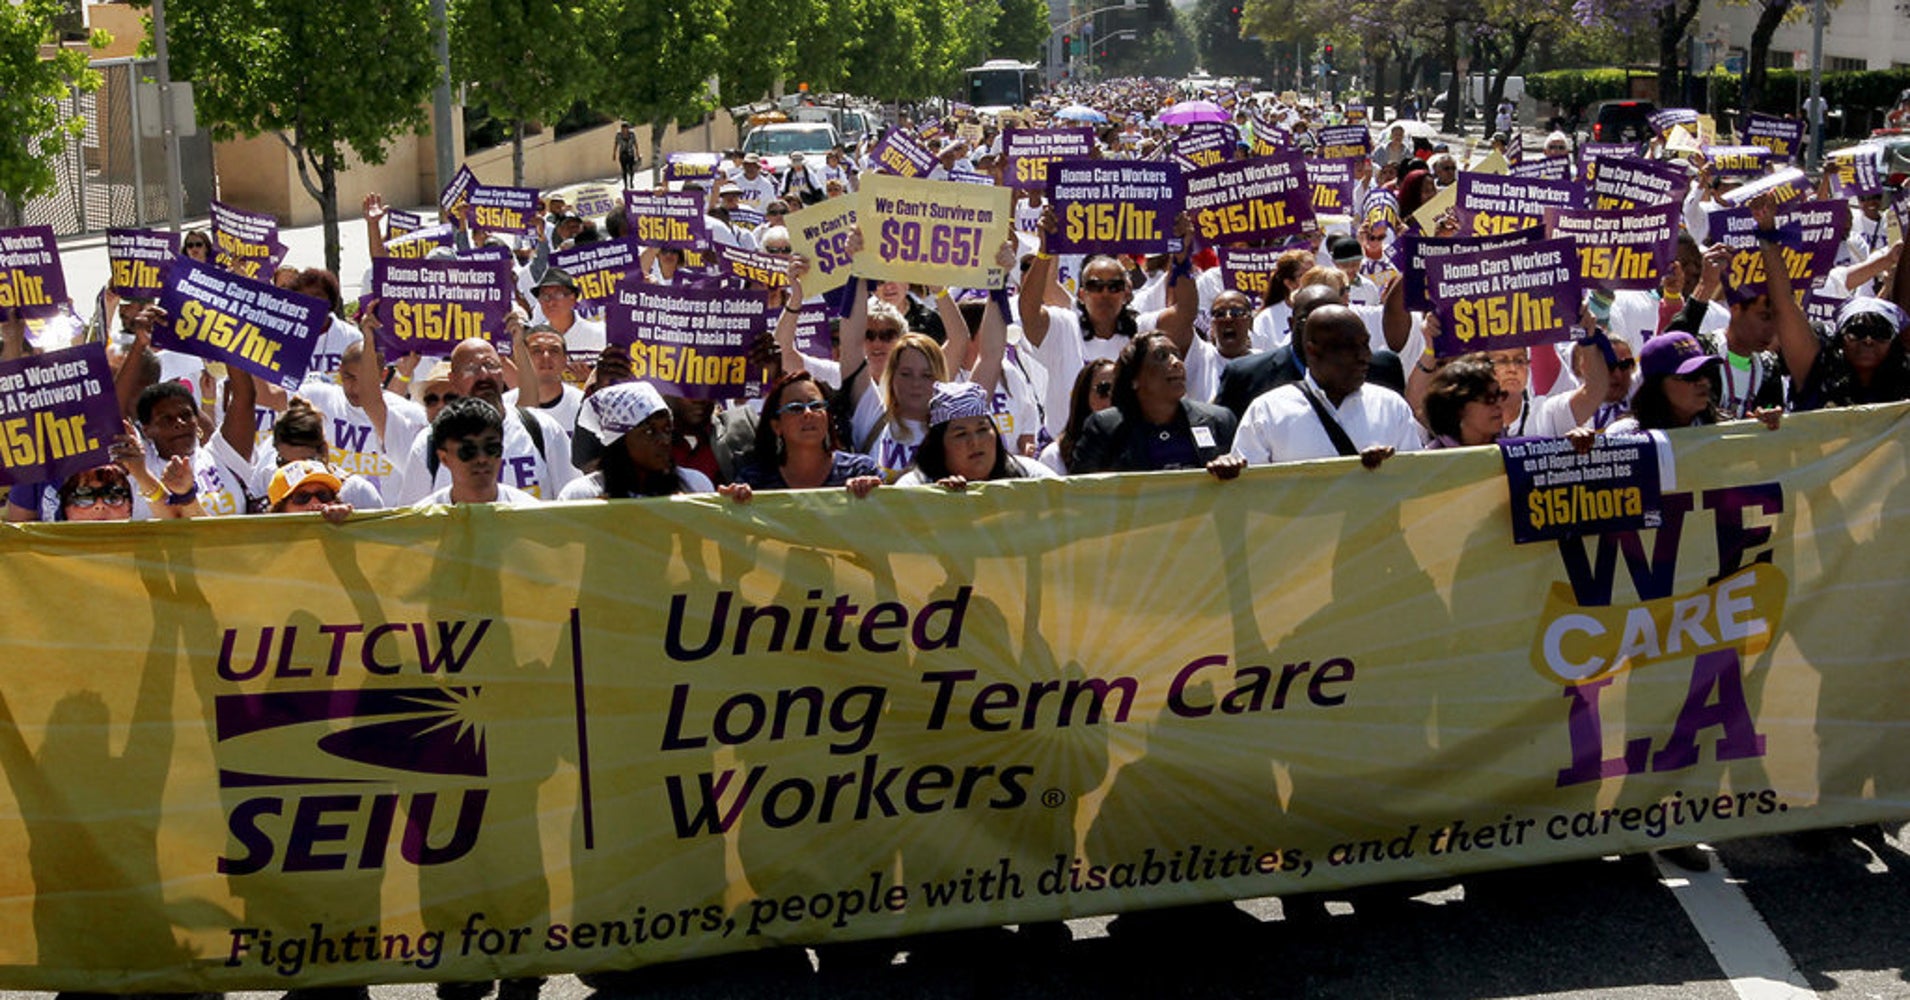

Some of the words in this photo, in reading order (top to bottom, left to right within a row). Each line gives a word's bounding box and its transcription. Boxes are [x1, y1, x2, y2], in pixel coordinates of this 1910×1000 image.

[1061, 169, 1093, 183] Home
[1094, 169, 1119, 183] Care
[1121, 168, 1166, 183] Workers
[1188, 178, 1217, 194] Home
[1218, 172, 1244, 187] Care
[1245, 163, 1290, 182] Workers
[1471, 180, 1500, 195] Home
[1502, 183, 1526, 198] Care
[1528, 185, 1570, 202] Workers
[875, 197, 894, 213] We
[897, 199, 927, 218] Can't
[930, 203, 975, 221] Survive
[976, 210, 993, 222] on
[1055, 185, 1100, 199] Deserve
[1101, 185, 1110, 198] A
[1112, 185, 1159, 201] Pathway
[1161, 186, 1172, 199] to
[1185, 191, 1228, 210] Deserve
[1229, 188, 1238, 201] A
[1239, 180, 1285, 200] Pathway
[1286, 177, 1299, 190] to
[1465, 194, 1507, 211] Deserve
[1508, 199, 1515, 212] A
[475, 206, 526, 229] $15/hr.
[638, 215, 694, 241] $15/hr.
[804, 225, 819, 241] We
[821, 214, 846, 234] Can't
[1066, 201, 1162, 243] $15/hr.
[1198, 200, 1295, 240] $15/hr.
[1559, 216, 1591, 231] Home
[1593, 217, 1620, 231] Care
[1622, 214, 1667, 230] Workers
[1727, 217, 1755, 232] Hom
[880, 217, 983, 267] $9.65!
[1600, 231, 1609, 244] A
[1610, 230, 1659, 244] Pathway
[1659, 228, 1670, 240] to
[387, 266, 417, 283] Home
[419, 267, 446, 283] Care
[448, 267, 495, 284] Workers
[1443, 263, 1479, 280] Home
[1480, 259, 1510, 276] Care
[1510, 250, 1562, 271] Workers
[1576, 246, 1658, 280] 15/hr.
[0, 269, 52, 307] 5/hr.
[189, 268, 226, 293] Home
[222, 279, 256, 304] Care
[257, 291, 309, 321] Workers
[382, 282, 427, 299] Deserve
[428, 284, 437, 299] A
[438, 284, 487, 303] Pathway
[488, 286, 501, 301] to
[1438, 280, 1490, 299] Deserve
[1491, 277, 1501, 292] A
[1502, 269, 1555, 292] Pathway
[1556, 266, 1570, 282] to
[176, 279, 227, 309] Deserve
[228, 297, 239, 315] A
[238, 301, 290, 337] Pathway
[291, 321, 309, 339] to
[619, 289, 637, 304] Los
[638, 291, 707, 314] Trabajadores
[708, 298, 723, 312] de
[724, 299, 764, 315] Cuidado
[1453, 292, 1564, 342] $15/hr.
[174, 298, 282, 372] $15/hr.
[392, 299, 492, 341] $15/hr.
[631, 310, 645, 322] en
[646, 310, 656, 324] el
[658, 312, 690, 328] Hogar
[691, 316, 705, 328] se
[706, 315, 751, 330] Merecen
[637, 327, 652, 339] un
[653, 327, 694, 344] Camino
[695, 329, 725, 345] hacia
[726, 331, 742, 346] los
[0, 374, 25, 393] are
[25, 359, 88, 387] Workers
[630, 340, 746, 386] $15/hora
[6, 394, 18, 414] A
[18, 383, 82, 412] Pathway
[84, 378, 101, 397] to
[0, 411, 99, 469] 15/hr.
[1507, 445, 1526, 458] Los
[1526, 438, 1574, 455] Trabajad
[1523, 459, 1537, 472] en
[1538, 456, 1548, 469] el
[1551, 453, 1575, 469] Hogar
[1577, 453, 1589, 465] se
[1590, 448, 1639, 463] Merecen
[1533, 474, 1546, 486] un
[1547, 469, 1582, 485] Camino
[1583, 465, 1612, 480] hacia
[1614, 463, 1632, 477] los
[1528, 485, 1642, 530] $15/hora
[1557, 482, 1784, 607] WE
[662, 585, 973, 663] United
[1543, 573, 1769, 681] CARE
[216, 618, 491, 682] ULTCW
[660, 683, 887, 756] Long
[919, 668, 1139, 732] Term
[1167, 654, 1356, 719] Care
[1555, 648, 1767, 788] LA
[216, 788, 489, 876] SEIU
[225, 923, 446, 976] Fighting
[460, 912, 533, 958] for
[543, 900, 737, 952] seniors,
[747, 872, 907, 938] people
[921, 857, 1023, 912] with
[1036, 838, 1314, 898] disabilities,
[1327, 825, 1419, 867] and
[1429, 814, 1536, 857] their
[1546, 788, 1788, 839] caregivers.
